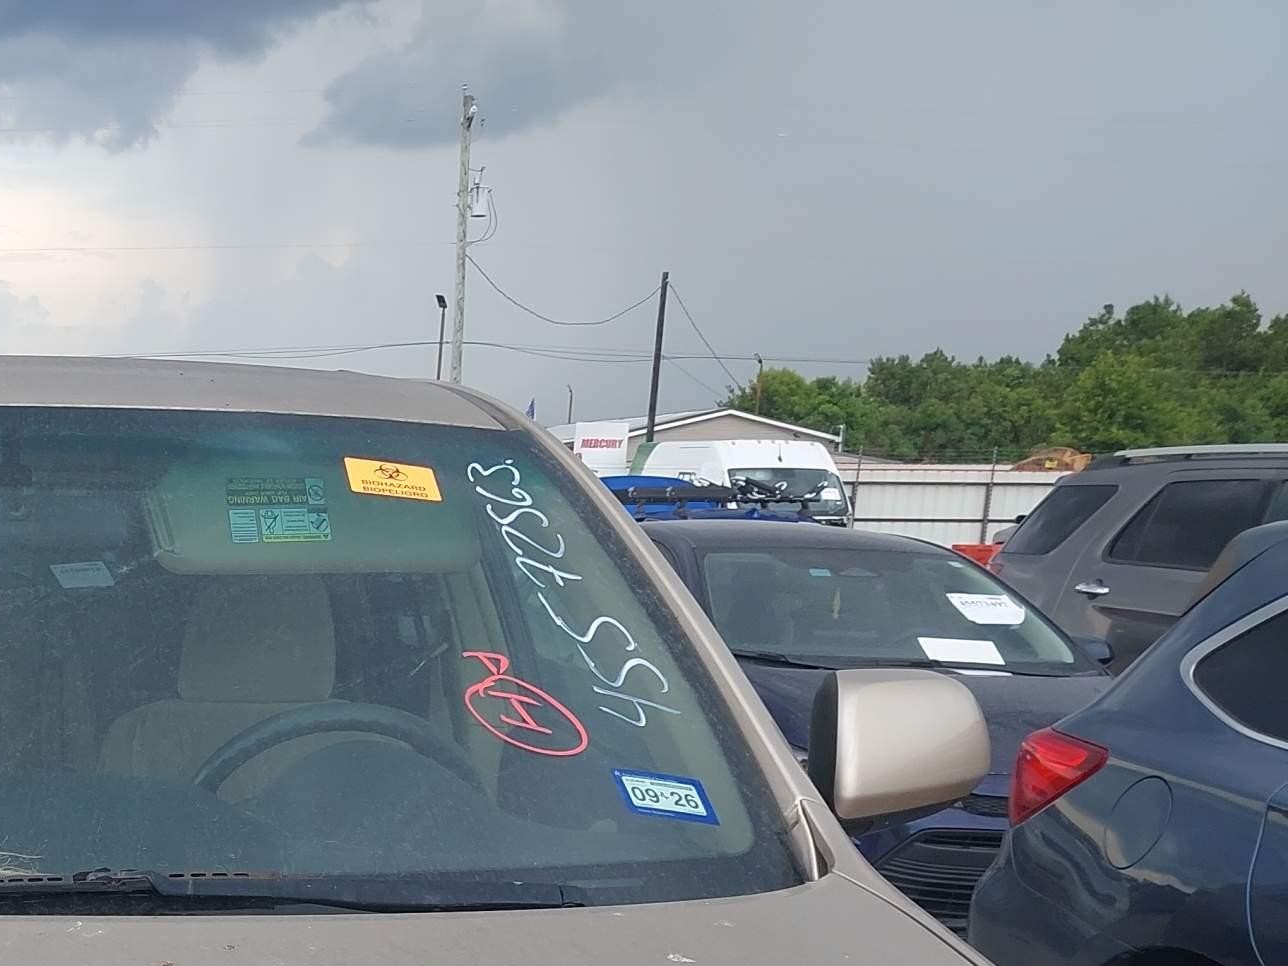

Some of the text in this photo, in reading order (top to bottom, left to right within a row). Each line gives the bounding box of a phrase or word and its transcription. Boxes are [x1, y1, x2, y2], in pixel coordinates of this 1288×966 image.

[581, 438, 624, 449] MERCURY
[361, 480, 427, 492] BIOHAZARD
[362, 486, 429, 498] BIOPELIGRO
[227, 495, 308, 504] AIR BAG WARNING
[468, 459, 682, 726] 45572563
[631, 786, 699, 809] 09 26
